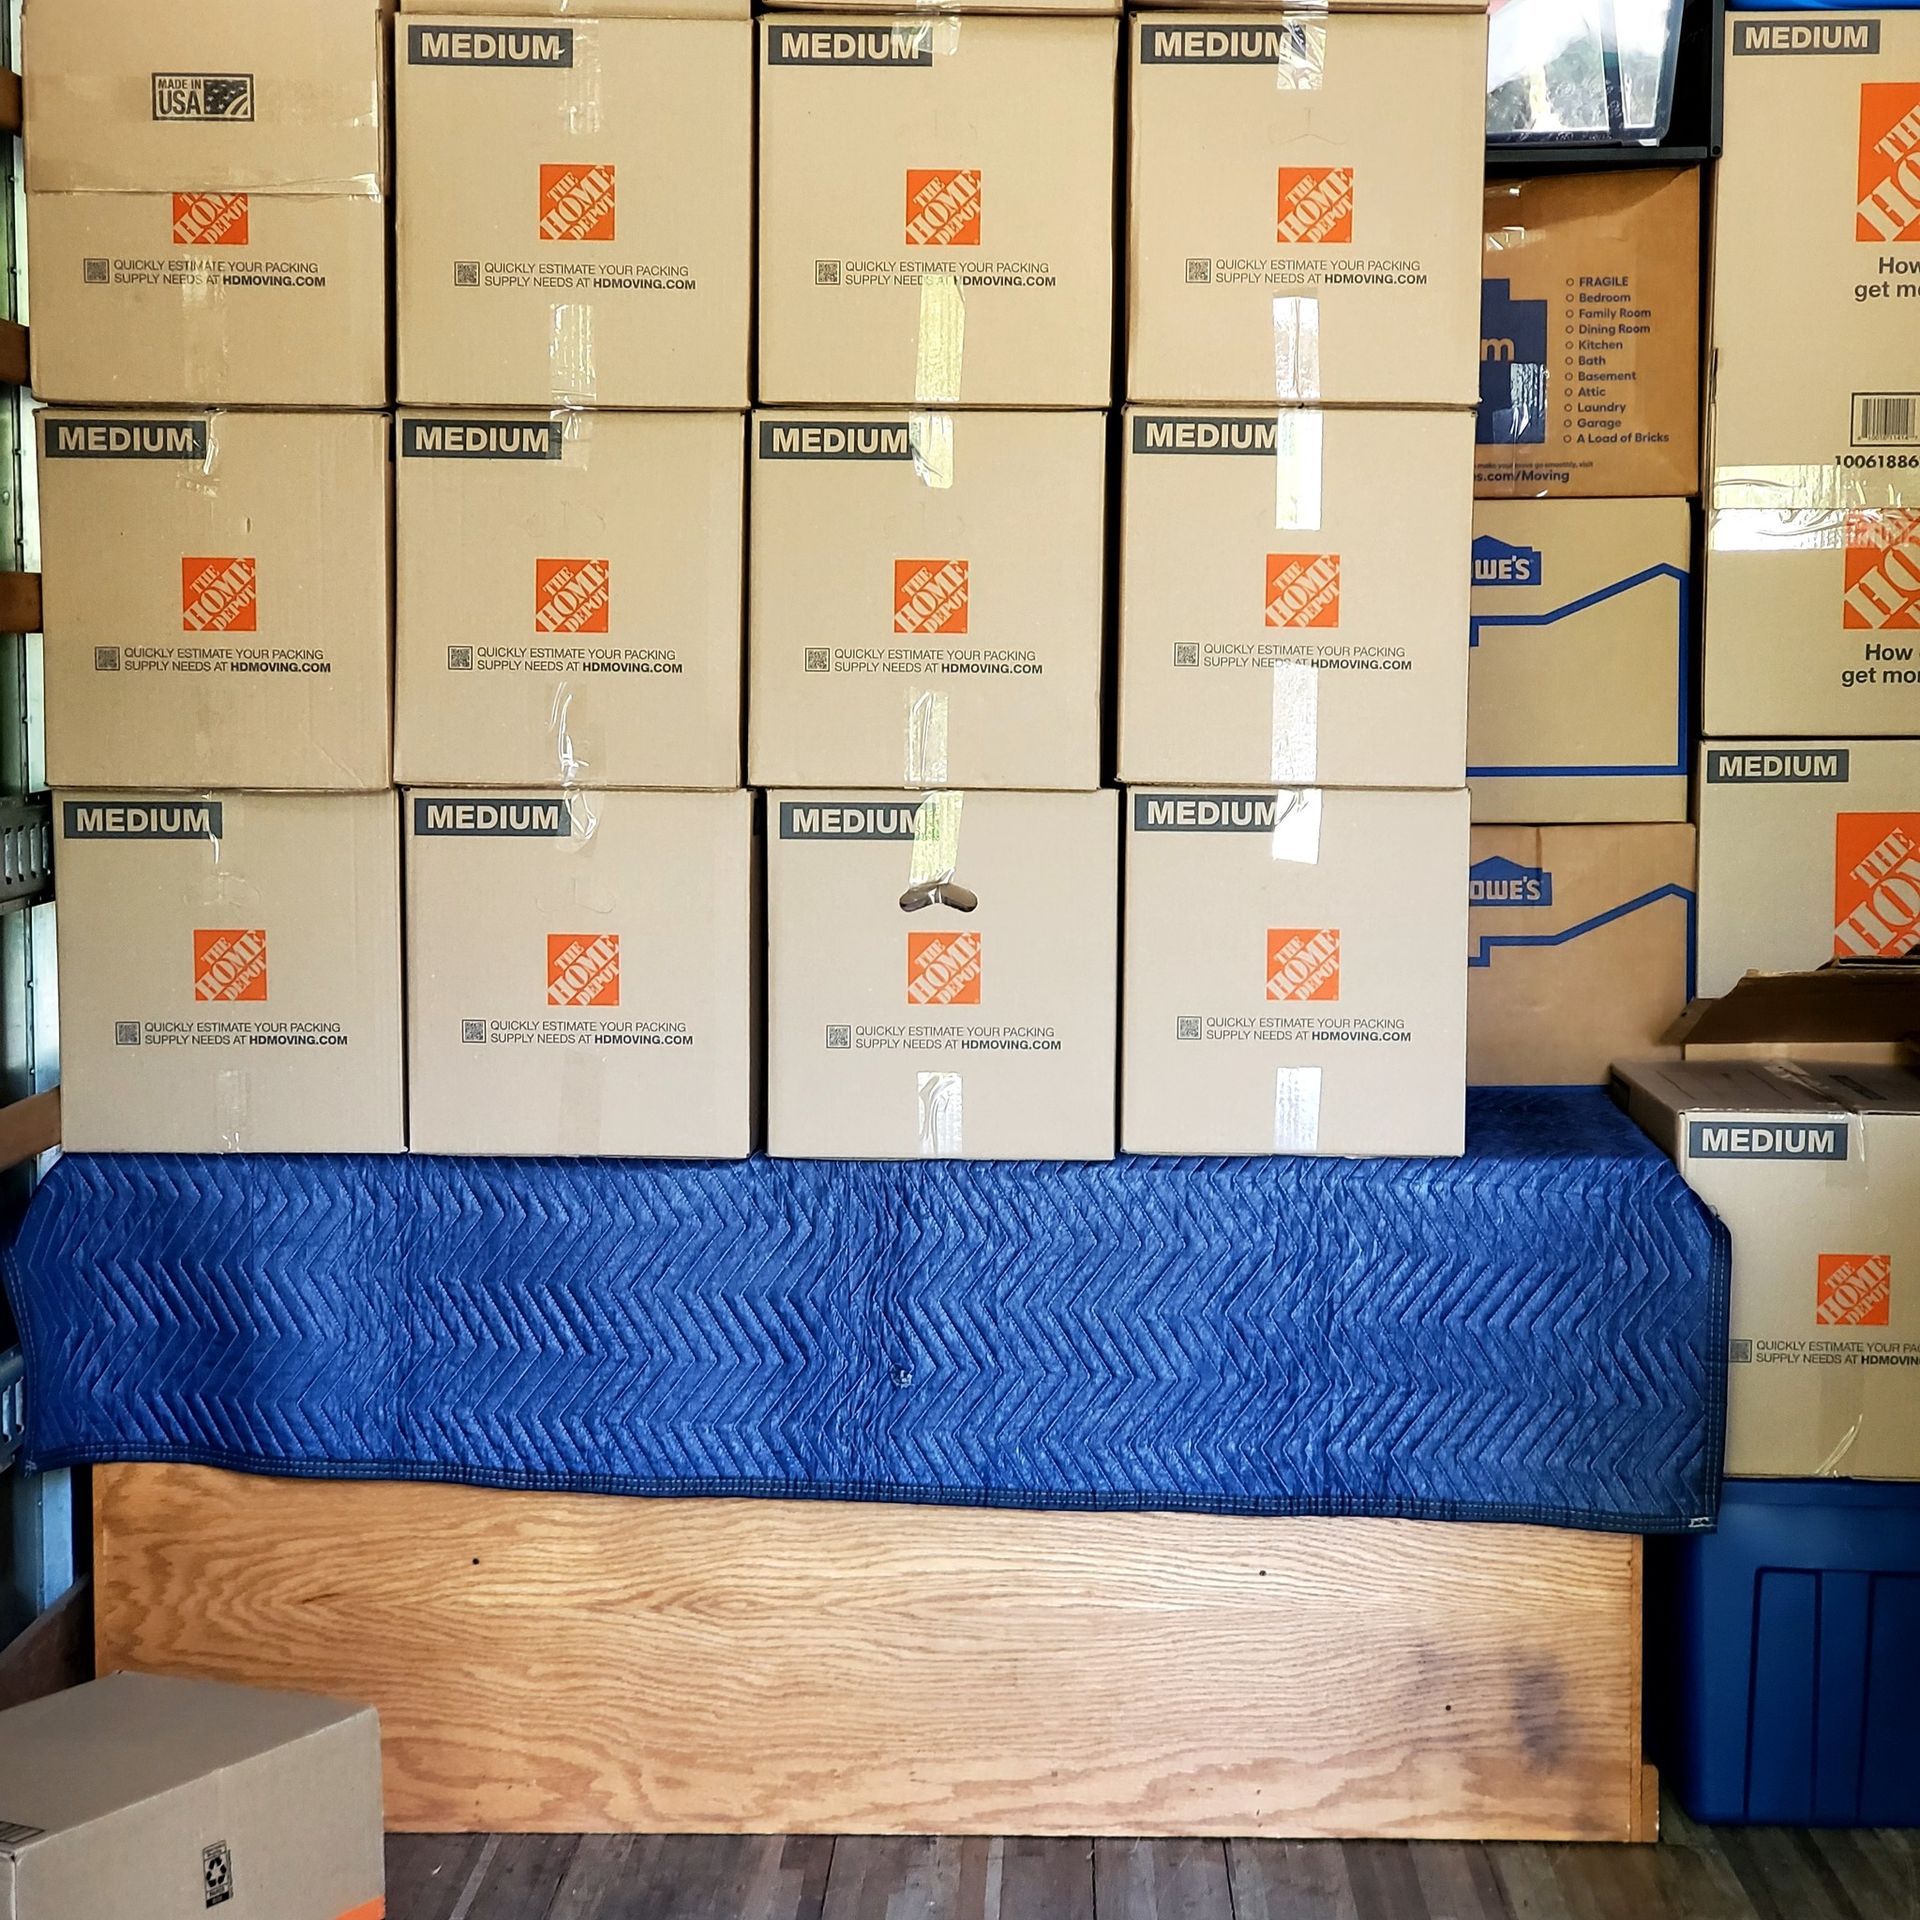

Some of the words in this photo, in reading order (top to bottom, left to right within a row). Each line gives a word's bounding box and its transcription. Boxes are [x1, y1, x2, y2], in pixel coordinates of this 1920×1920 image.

[422, 32, 560, 60] MEDIUM
[782, 32, 919, 60] MEDIUM
[1746, 26, 1868, 49] MEDIUM
[158, 79, 188, 90] MADE
[190, 79, 202, 90] IN
[158, 90, 202, 115] USA
[547, 172, 578, 201] THE
[913, 177, 944, 207] THE
[1284, 175, 1316, 204] THE
[540, 165, 614, 240] HOME
[906, 171, 980, 244] HOME
[1278, 168, 1352, 242] HOME
[570, 192, 614, 240] DEPOT
[936, 198, 980, 244] DEPOT
[1308, 195, 1352, 242] DEPOT
[114, 260, 165, 272] QUICKLY
[168, 261, 226, 272] ESTIMATE
[228, 261, 263, 272] YOUR
[266, 262, 318, 273] PACKING
[484, 262, 536, 275] QUICKLY
[539, 263, 596, 275] ESTIMATE
[598, 265, 633, 276] YOUR
[636, 265, 689, 277] PACKING
[1216, 259, 1267, 271] QUICKLY
[1270, 259, 1327, 271] ESTIMATE
[1329, 260, 1364, 271] YOUR
[1368, 260, 1420, 272] PACKING
[114, 273, 161, 284] SUPPLY
[163, 274, 203, 285] NEEDS
[205, 274, 221, 285] AT
[222, 274, 326, 287] HDMOVING.COM
[484, 276, 531, 288] SUPPLY
[534, 277, 573, 289] NEEDS
[576, 278, 591, 289] AT
[593, 278, 696, 291] HDMOVING.COM
[1216, 273, 1263, 284] SUPPLY
[1265, 273, 1304, 284] NEEDS
[1307, 274, 1322, 284] AT
[1324, 274, 1427, 285] HDMOVING.COM
[1580, 276, 1628, 287] FRAGILE
[1854, 281, 1890, 302] get
[1580, 293, 1630, 303] Bedroom
[1580, 309, 1616, 320] Family
[1620, 308, 1651, 318] Room
[1579, 324, 1616, 336] Dining
[1618, 324, 1650, 334] Room
[1578, 340, 1623, 350] Kitchen
[1578, 356, 1606, 366] Bath
[1578, 371, 1636, 381] Basement
[1578, 388, 1606, 397] Attic
[1578, 403, 1626, 414] Laundry
[1146, 423, 1278, 448] MEDIUM
[1577, 418, 1622, 429] Garage
[58, 426, 193, 452] MEDIUM
[416, 426, 548, 452] MEDIUM
[772, 428, 908, 454] MEDIUM
[1577, 434, 1585, 444] A
[1588, 434, 1618, 443] Load
[1620, 432, 1632, 442] of
[1635, 432, 1670, 442] Bricks
[1835, 455, 1920, 468] 10061886
[1272, 561, 1303, 590] THE
[1475, 555, 1530, 580] WE'S
[902, 568, 932, 596] THE
[1266, 555, 1340, 627] HOME
[895, 561, 968, 632] HOME
[1296, 581, 1340, 627] DEPOT
[925, 587, 968, 632] DEPOT
[124, 648, 175, 659] QUICKLY
[177, 648, 233, 659] ESTIMATE
[235, 649, 269, 660] YOUR
[273, 649, 324, 660] PACKING
[477, 647, 527, 659] QUICKLY
[530, 647, 586, 659] ESTIMATE
[588, 648, 622, 660] YOUR
[625, 649, 676, 660] PACKING
[834, 648, 885, 660] QUICKLY
[888, 649, 944, 660] ESTIMATE
[946, 650, 981, 661] YOUR
[984, 650, 1035, 661] PACKING
[1866, 644, 1914, 660] How
[124, 661, 170, 672] SUPPLY
[172, 661, 211, 672] NEEDS
[213, 662, 228, 672] AT
[230, 662, 331, 673] HDMOVING.COM
[477, 660, 522, 672] SUPPLY
[525, 661, 563, 672] NEEDS
[566, 662, 581, 672] AT
[582, 662, 683, 674] HDMOVING.COM
[834, 662, 880, 673] SUPPLY
[883, 663, 922, 673] NEEDS
[924, 663, 939, 673] AT
[941, 663, 1043, 674] HDMOVING.COM
[1842, 667, 1877, 688] get
[1718, 755, 1838, 777] MEDIUM
[77, 808, 210, 832] MEDIUM
[428, 805, 558, 830] MEDIUM
[1148, 801, 1277, 826] MEDIUM
[1850, 827, 1916, 888] THE
[1470, 876, 1541, 900] OWE'S
[554, 941, 584, 969] THE
[915, 940, 945, 968] THE
[1273, 936, 1304, 964] THE
[548, 935, 620, 1006] HOME
[908, 933, 981, 1004] HOME
[1266, 930, 1340, 1000] HOME
[1296, 955, 1340, 1000] DEPOT
[577, 960, 620, 1006] DEPOT
[938, 959, 981, 1004] DEPOT
[144, 1022, 194, 1033] QUICKLY
[196, 1022, 252, 1033] ESTIMATE
[254, 1022, 287, 1033] YOUR
[290, 1022, 340, 1033] PACKING
[490, 1020, 540, 1031] QUICKLY
[542, 1021, 597, 1031] ESTIMATE
[599, 1021, 633, 1032] YOUR
[636, 1022, 686, 1032] PACKING
[1206, 1017, 1256, 1029] QUICKLY
[1259, 1017, 1314, 1029] ESTIMATE
[1316, 1018, 1350, 1029] YOUR
[1353, 1018, 1404, 1029] PACKING
[144, 1035, 189, 1045] SUPPLY
[192, 1035, 230, 1045] NEEDS
[232, 1035, 247, 1045] AT
[249, 1035, 348, 1045] HDMOVING.COM
[490, 1033, 535, 1043] SUPPLY
[537, 1033, 575, 1044] NEEDS
[578, 1034, 593, 1044] AT
[594, 1034, 693, 1045] HDMOVING.COM
[1206, 1030, 1251, 1040] SUPPLY
[1254, 1030, 1292, 1041] NEEDS
[1294, 1031, 1309, 1041] AT
[1311, 1031, 1411, 1042] HDMOVING.COM
[1702, 1128, 1834, 1154] MEDIUM
[1825, 1262, 1854, 1289] THE
[1816, 1255, 1890, 1324] HOME
[1846, 1280, 1890, 1324] DEPOT
